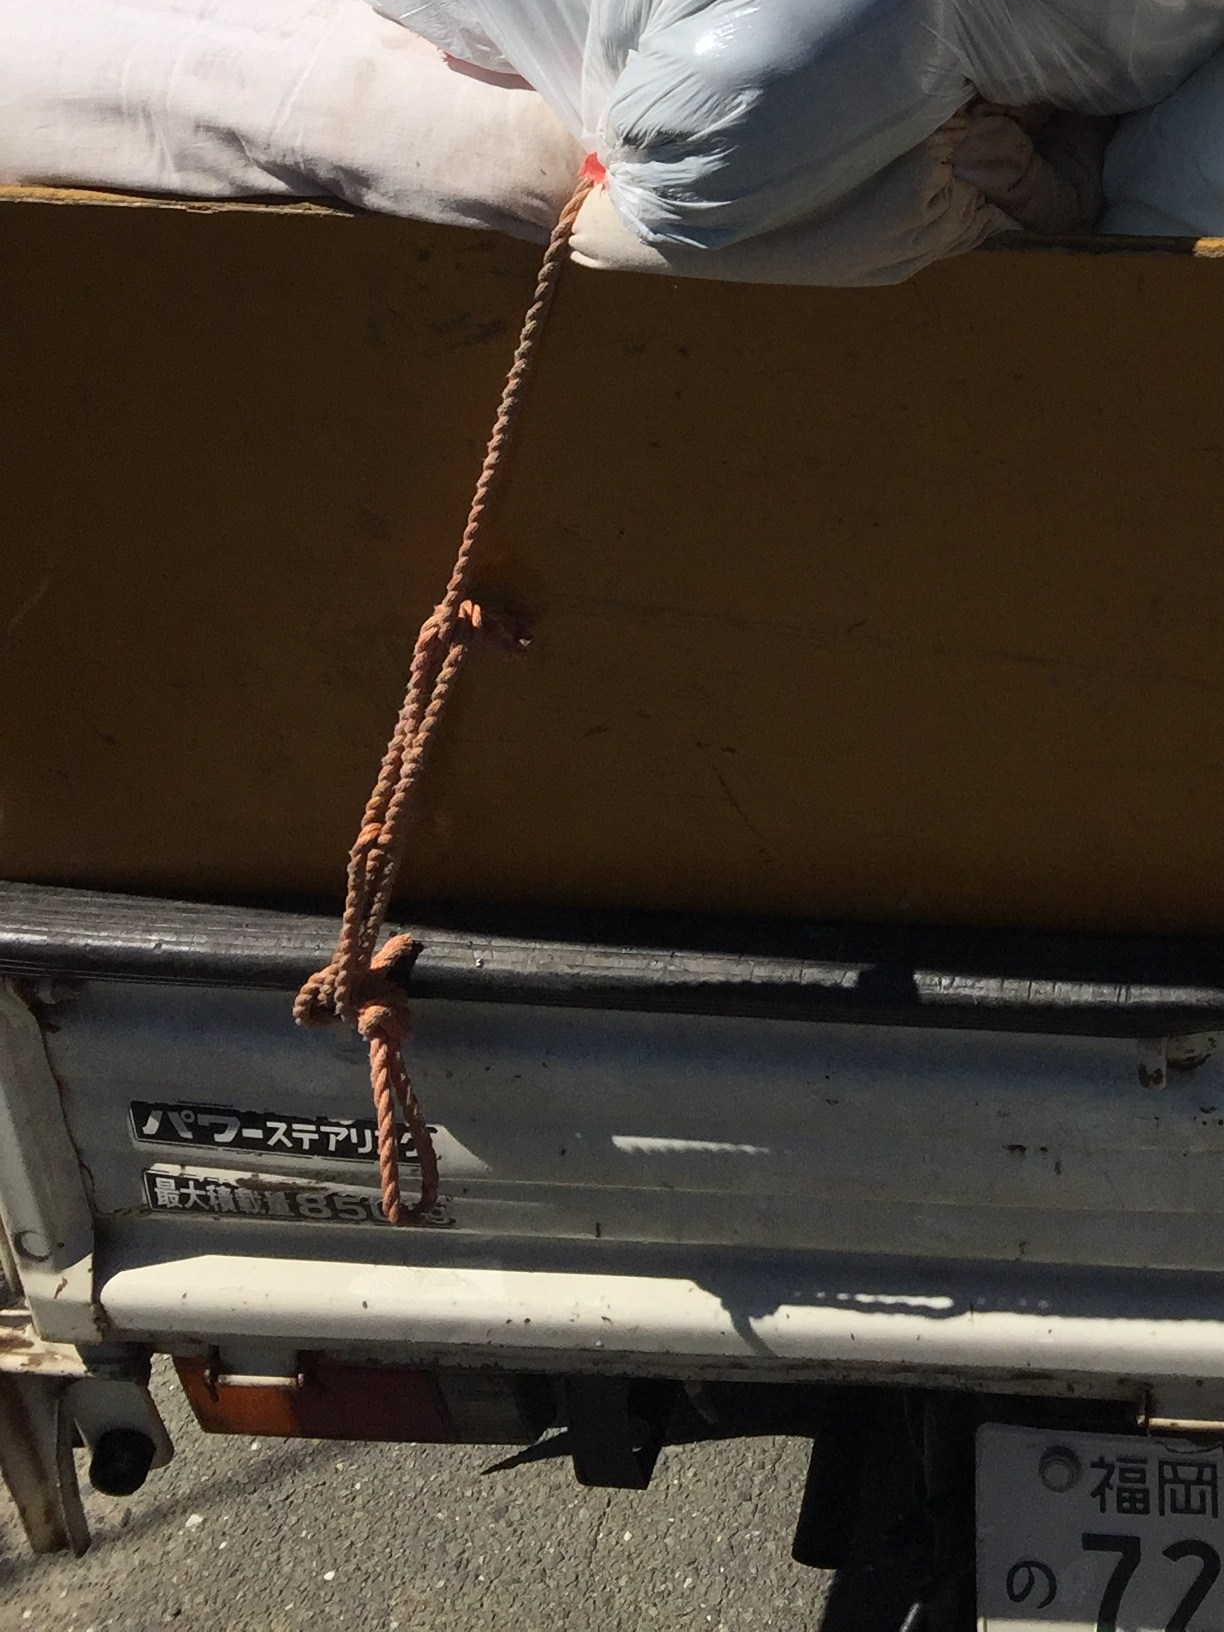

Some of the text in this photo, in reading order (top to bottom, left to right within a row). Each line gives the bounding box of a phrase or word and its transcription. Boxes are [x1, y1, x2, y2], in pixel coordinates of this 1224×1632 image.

[142, 1108, 424, 1158] パワーステアリ
[1089, 1456, 1219, 1520] 福岡
[1005, 1559, 1058, 1610] の
